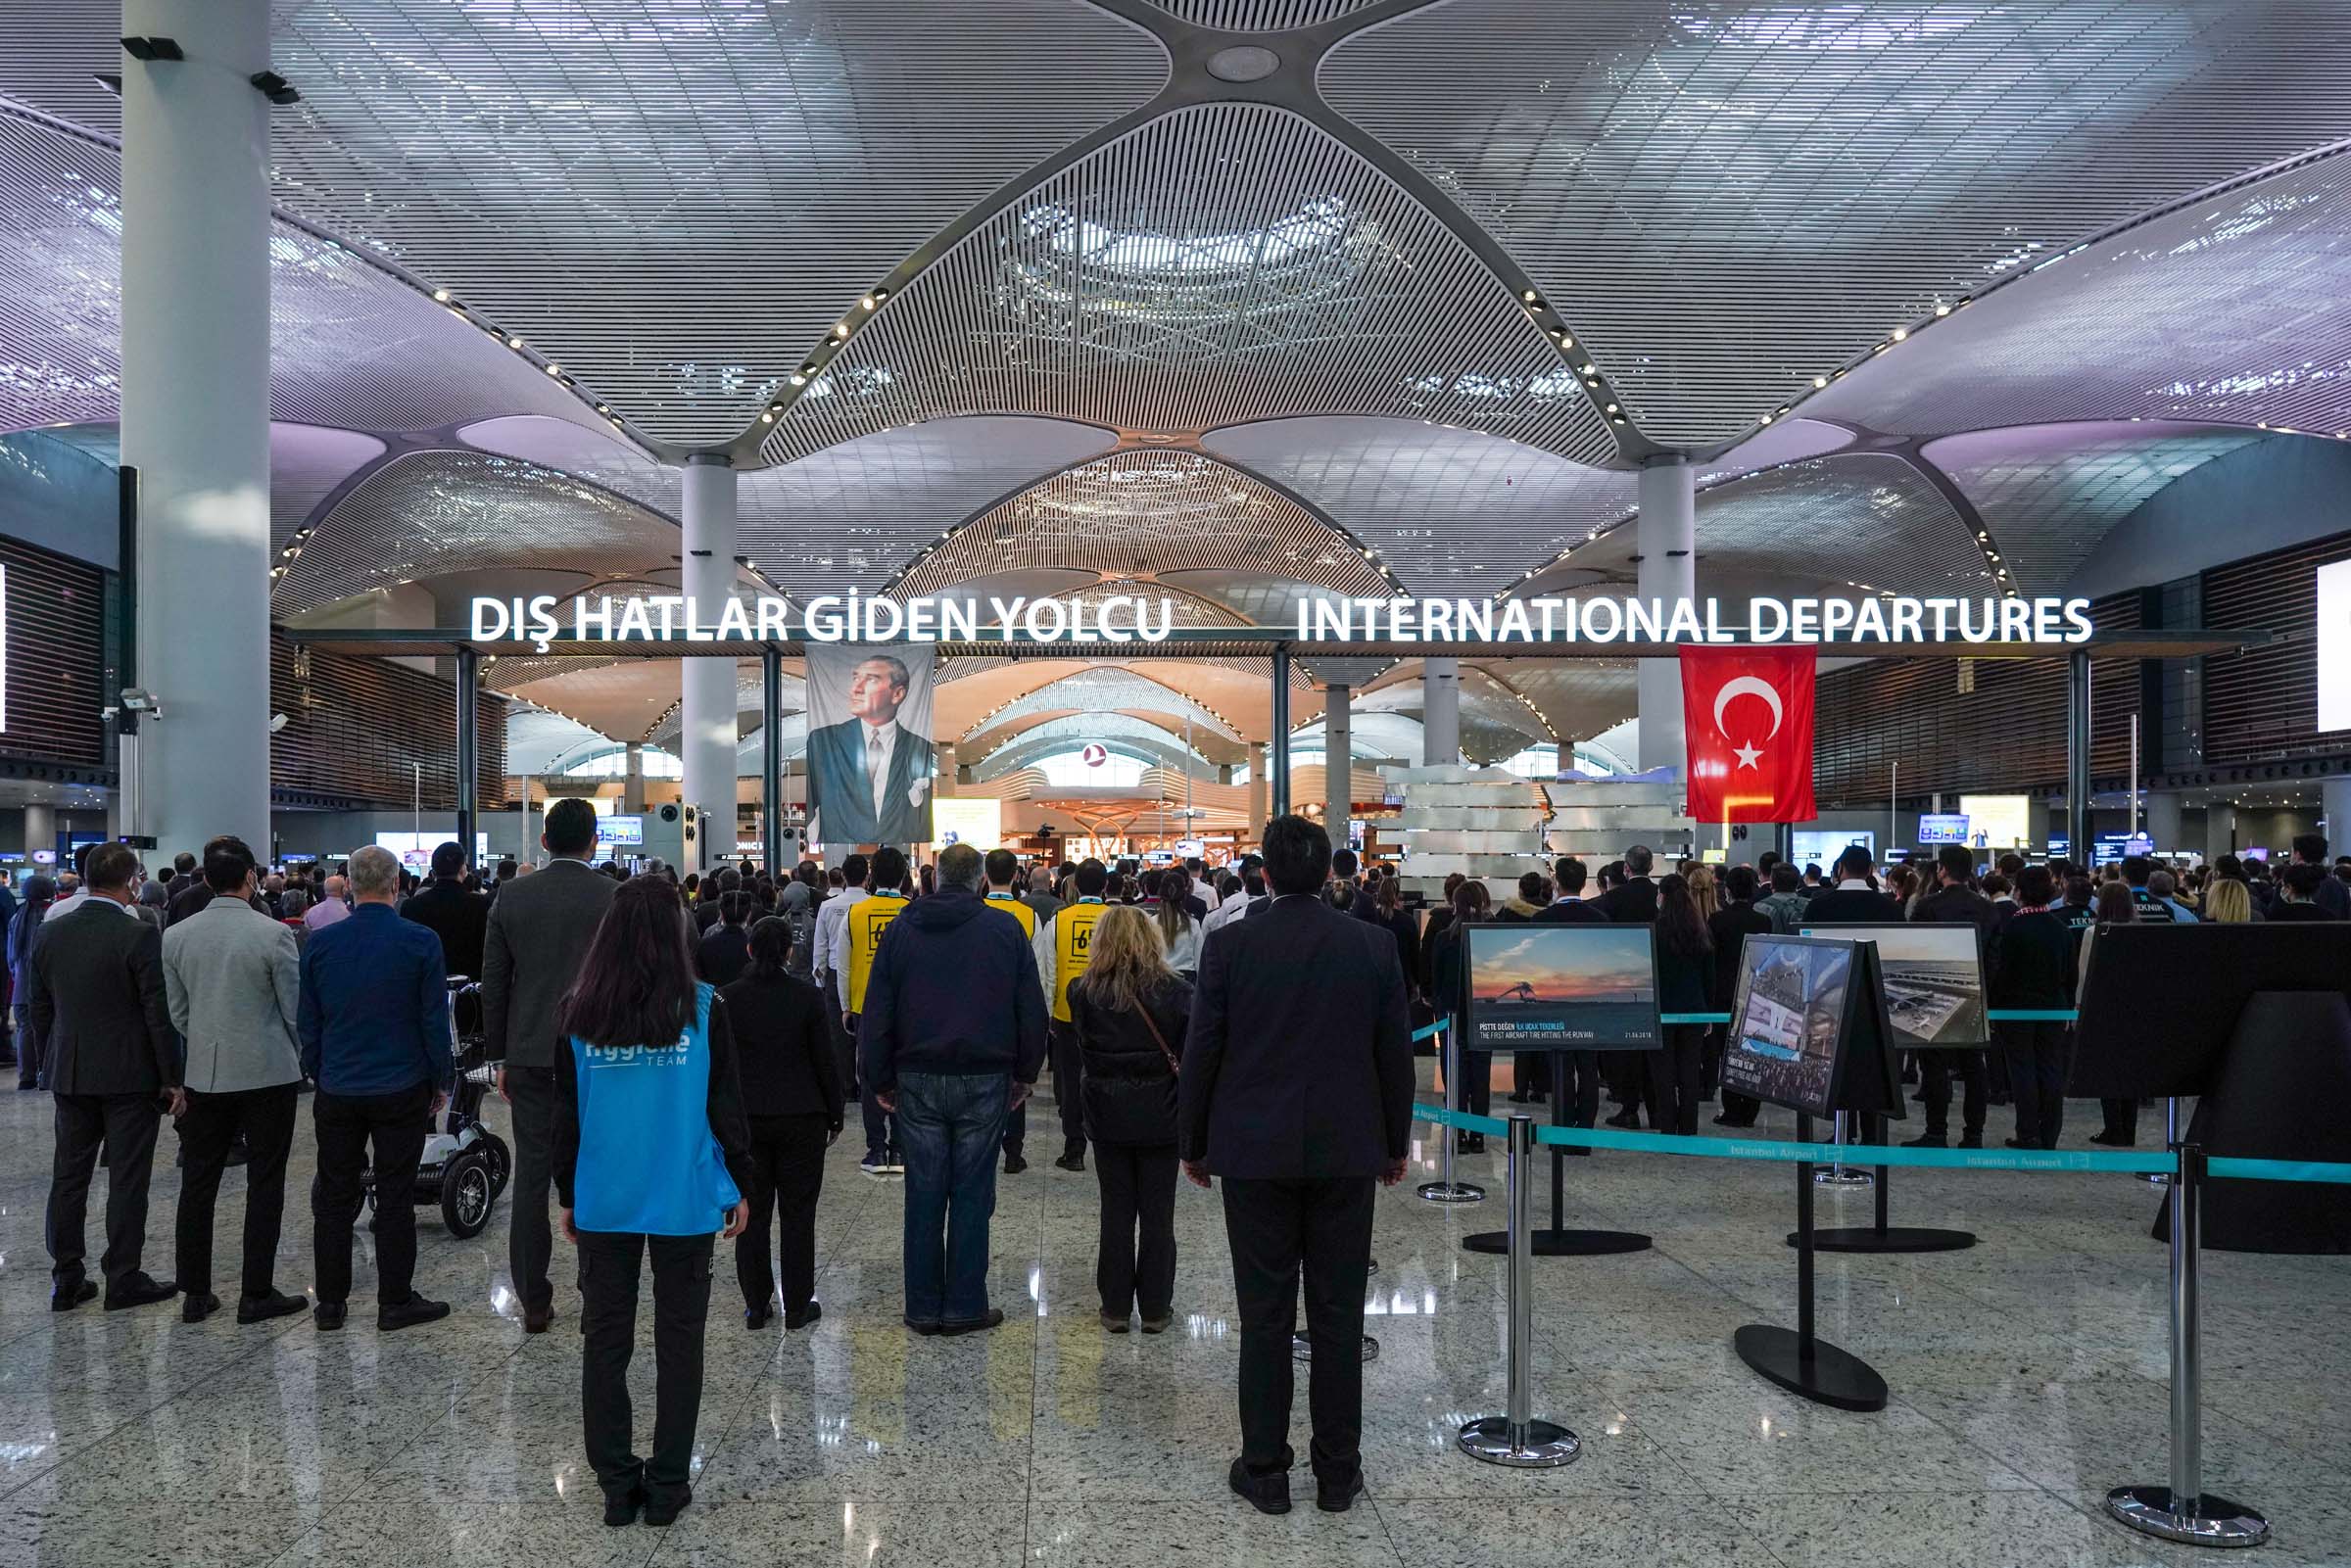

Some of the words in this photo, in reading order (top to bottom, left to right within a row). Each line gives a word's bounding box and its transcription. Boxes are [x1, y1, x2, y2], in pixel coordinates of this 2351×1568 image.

[471, 595, 559, 653] DIŞ
[575, 595, 789, 641] HATLAR
[804, 587, 978, 641] GİDEN
[989, 595, 1172, 641] YOLCU
[1298, 596, 1734, 642] INTERNATIONAL
[1750, 596, 2094, 642] DEPARTURES
[647, 1055, 687, 1066] TEAM
[1780, 1148, 1818, 1161] Airport
